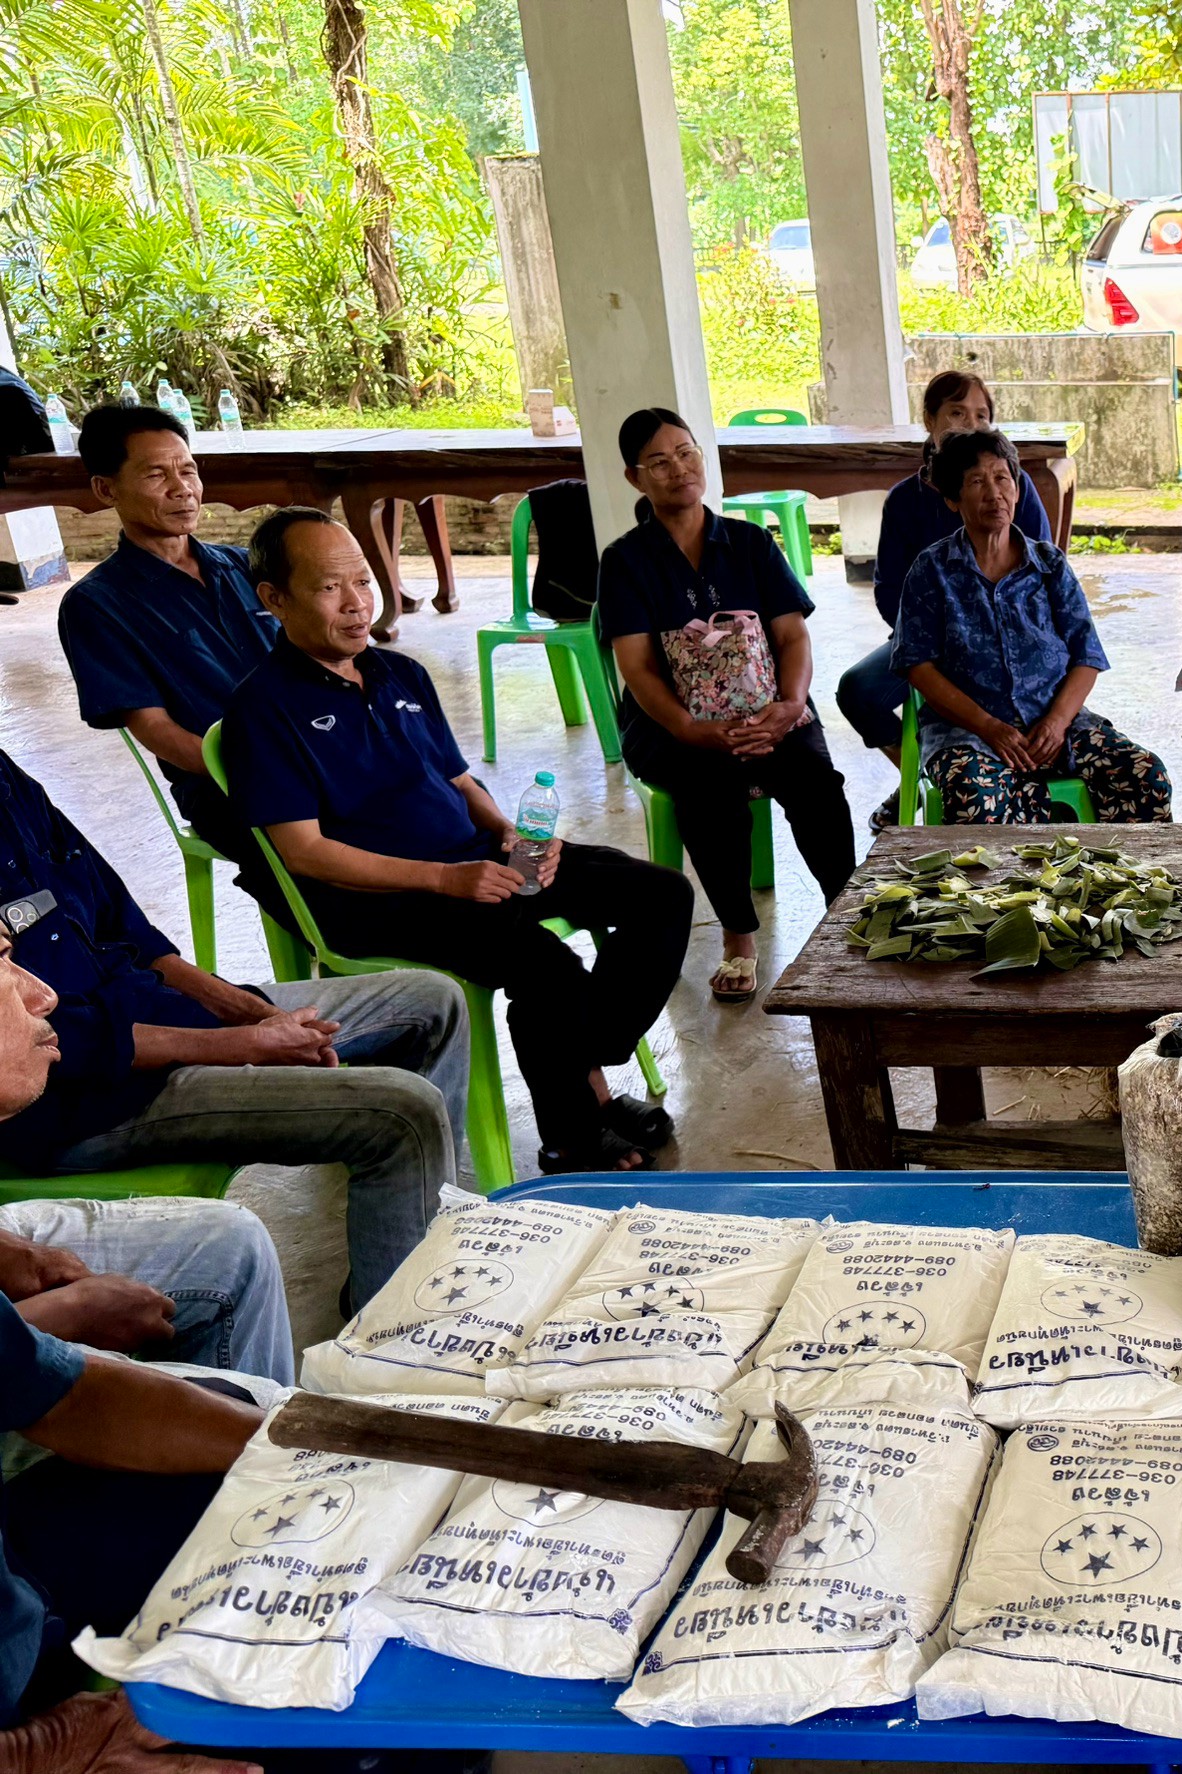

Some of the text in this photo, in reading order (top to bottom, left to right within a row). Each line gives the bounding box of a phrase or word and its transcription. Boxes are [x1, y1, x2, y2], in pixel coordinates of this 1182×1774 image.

[451, 1226, 550, 1243] 036-377748
[641, 1237, 751, 1256] 089-4442088
[638, 1250, 740, 1265] 036-377748
[842, 1254, 956, 1266] 089-4442088
[842, 1265, 947, 1277] 036-377748
[855, 1280, 923, 1297] เจ้ล้วง
[813, 1439, 917, 1464] 089-44420
[817, 1454, 905, 1478] 036-377
[1052, 1469, 1177, 1485] 036-377748
[818, 1473, 875, 1499] เจ้ล้ว
[1071, 1486, 1150, 1506] เจ้ล้วง
